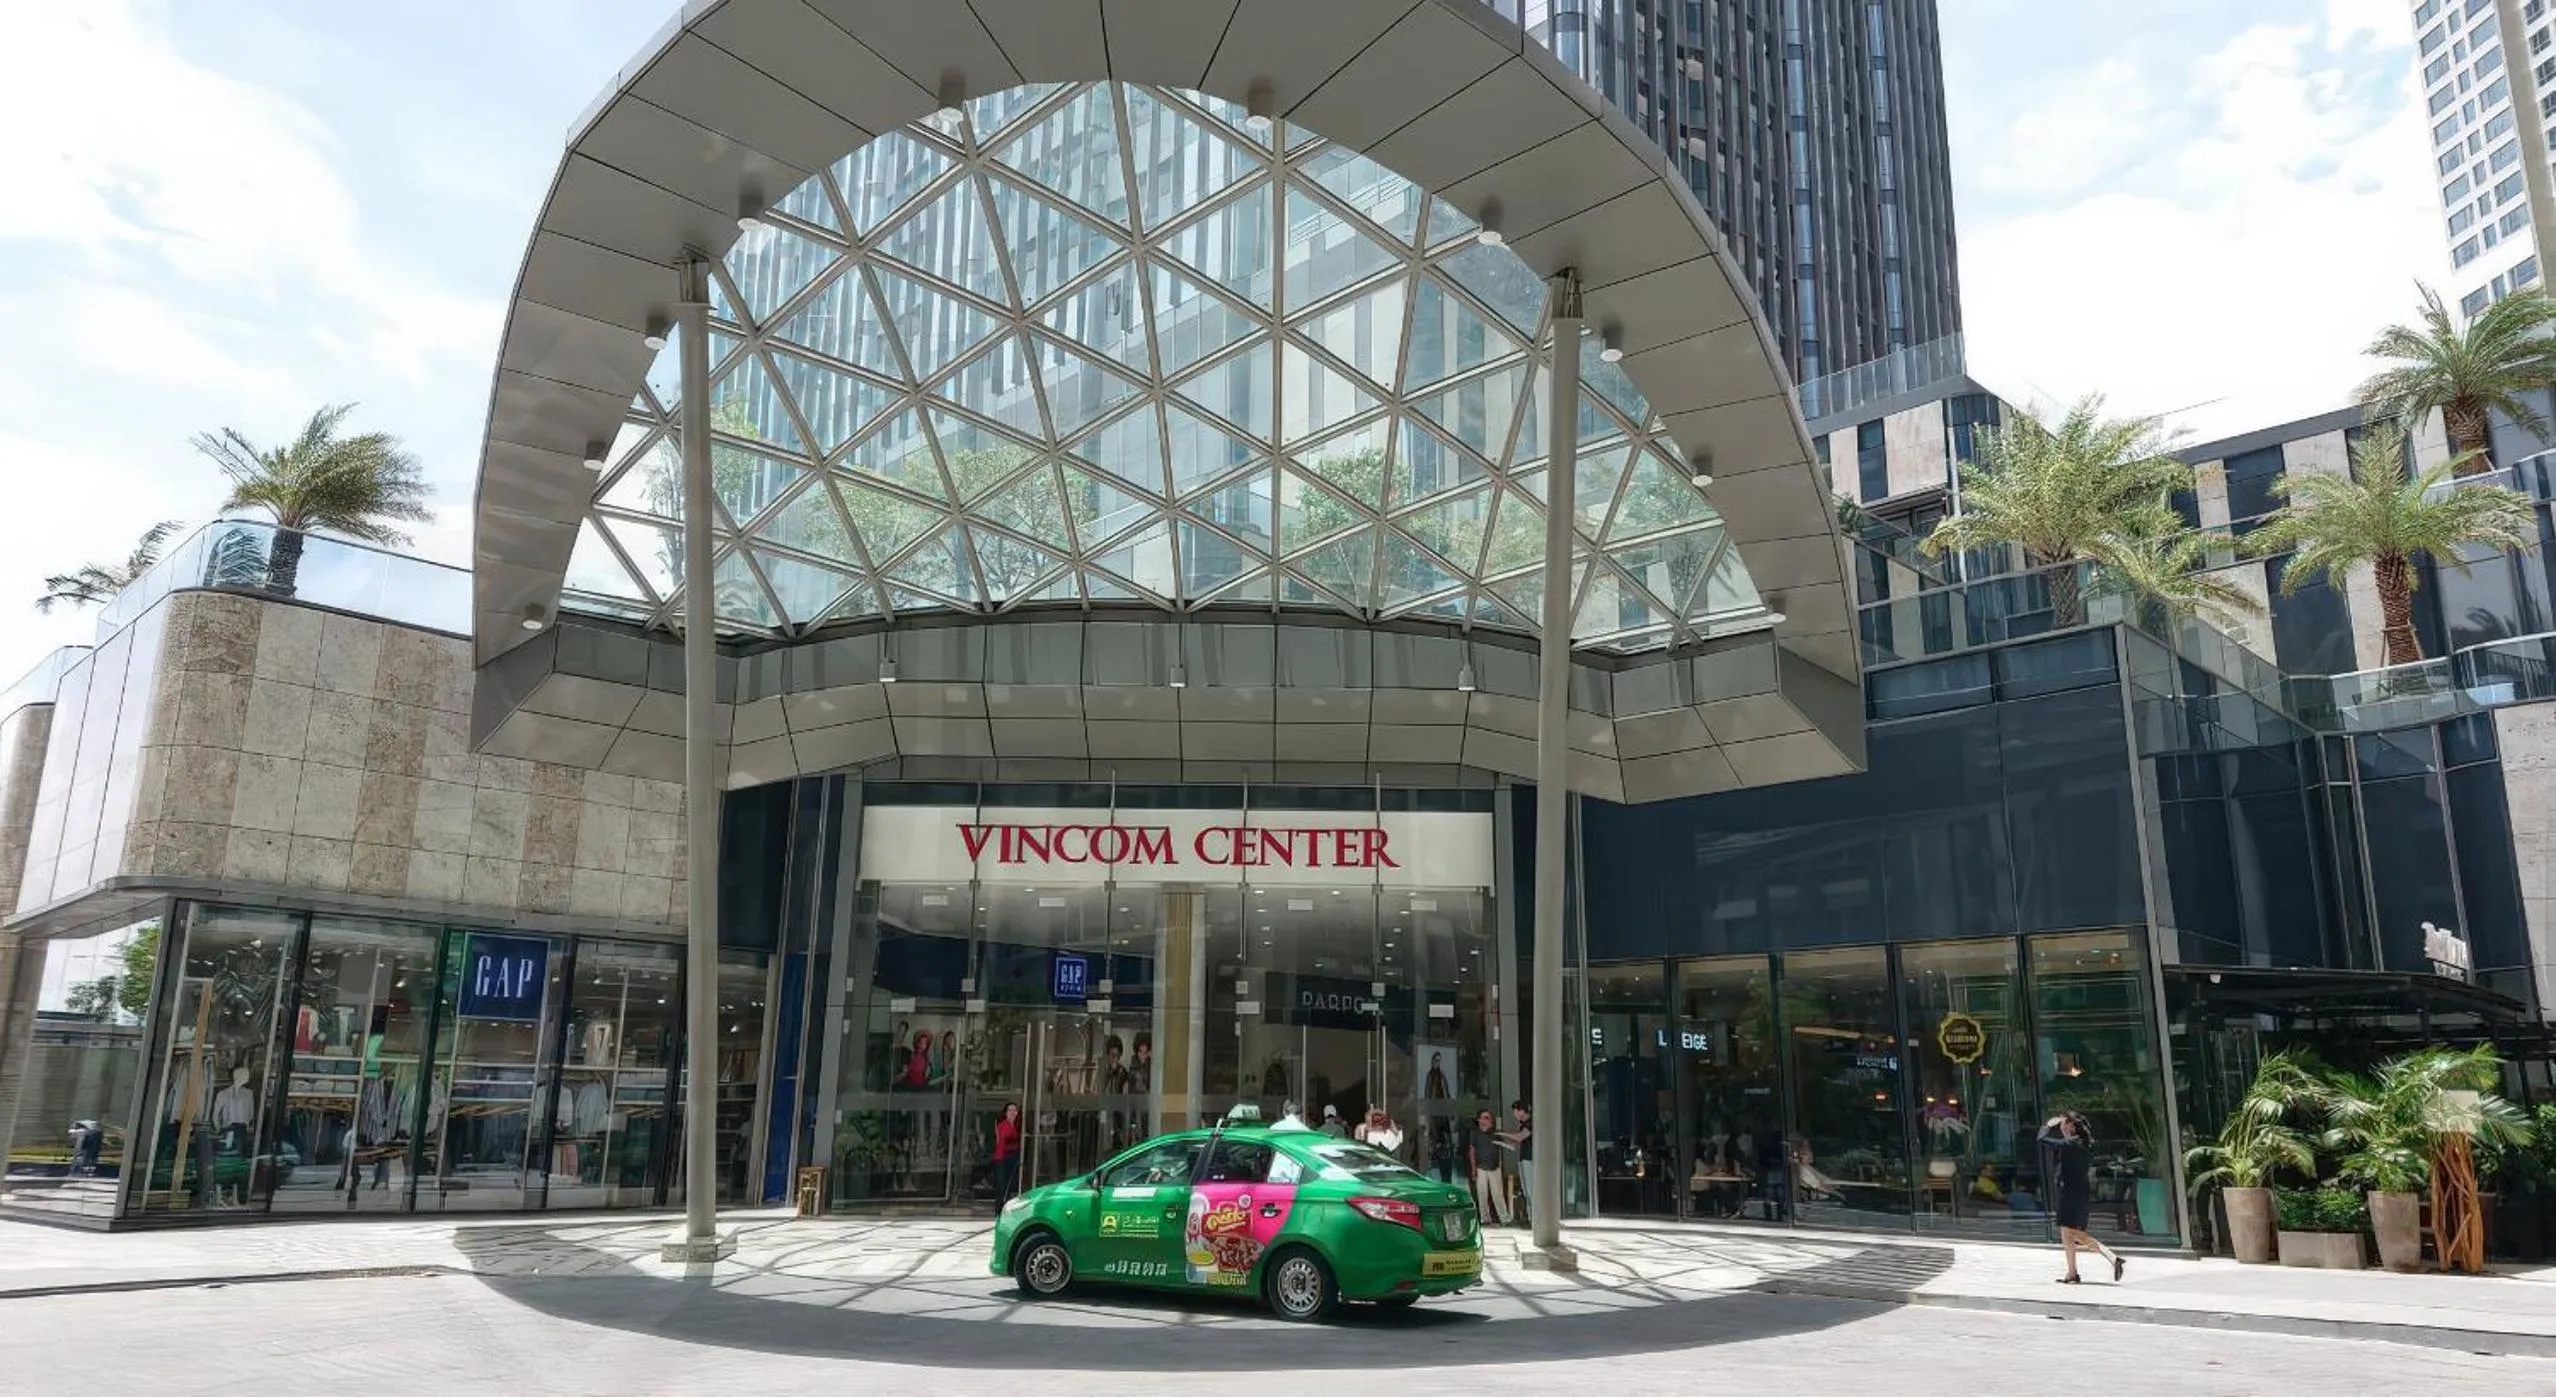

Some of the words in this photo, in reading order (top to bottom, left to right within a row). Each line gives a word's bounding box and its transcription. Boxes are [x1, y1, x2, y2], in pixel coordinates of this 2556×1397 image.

[958, 824, 1179, 866] VINCOM
[1194, 826, 1401, 869] CENTER
[475, 954, 534, 999] GAP
